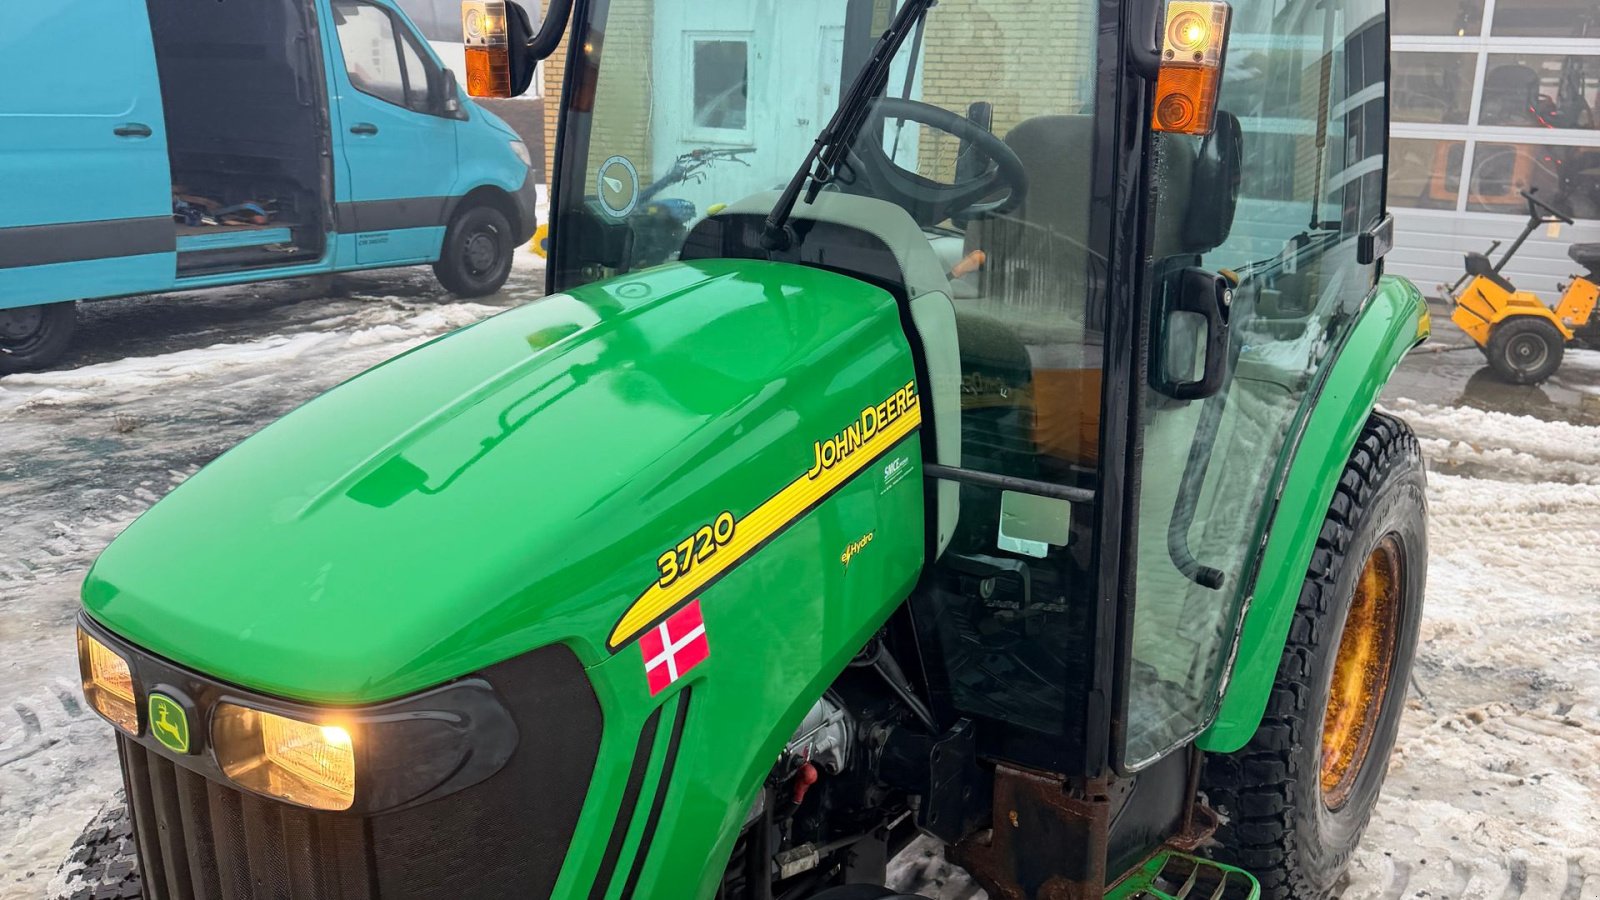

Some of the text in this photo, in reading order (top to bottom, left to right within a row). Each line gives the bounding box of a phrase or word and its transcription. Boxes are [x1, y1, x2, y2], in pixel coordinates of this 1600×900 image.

[808, 379, 916, 480] JOHN DEERE
[656, 509, 735, 589] 3720
